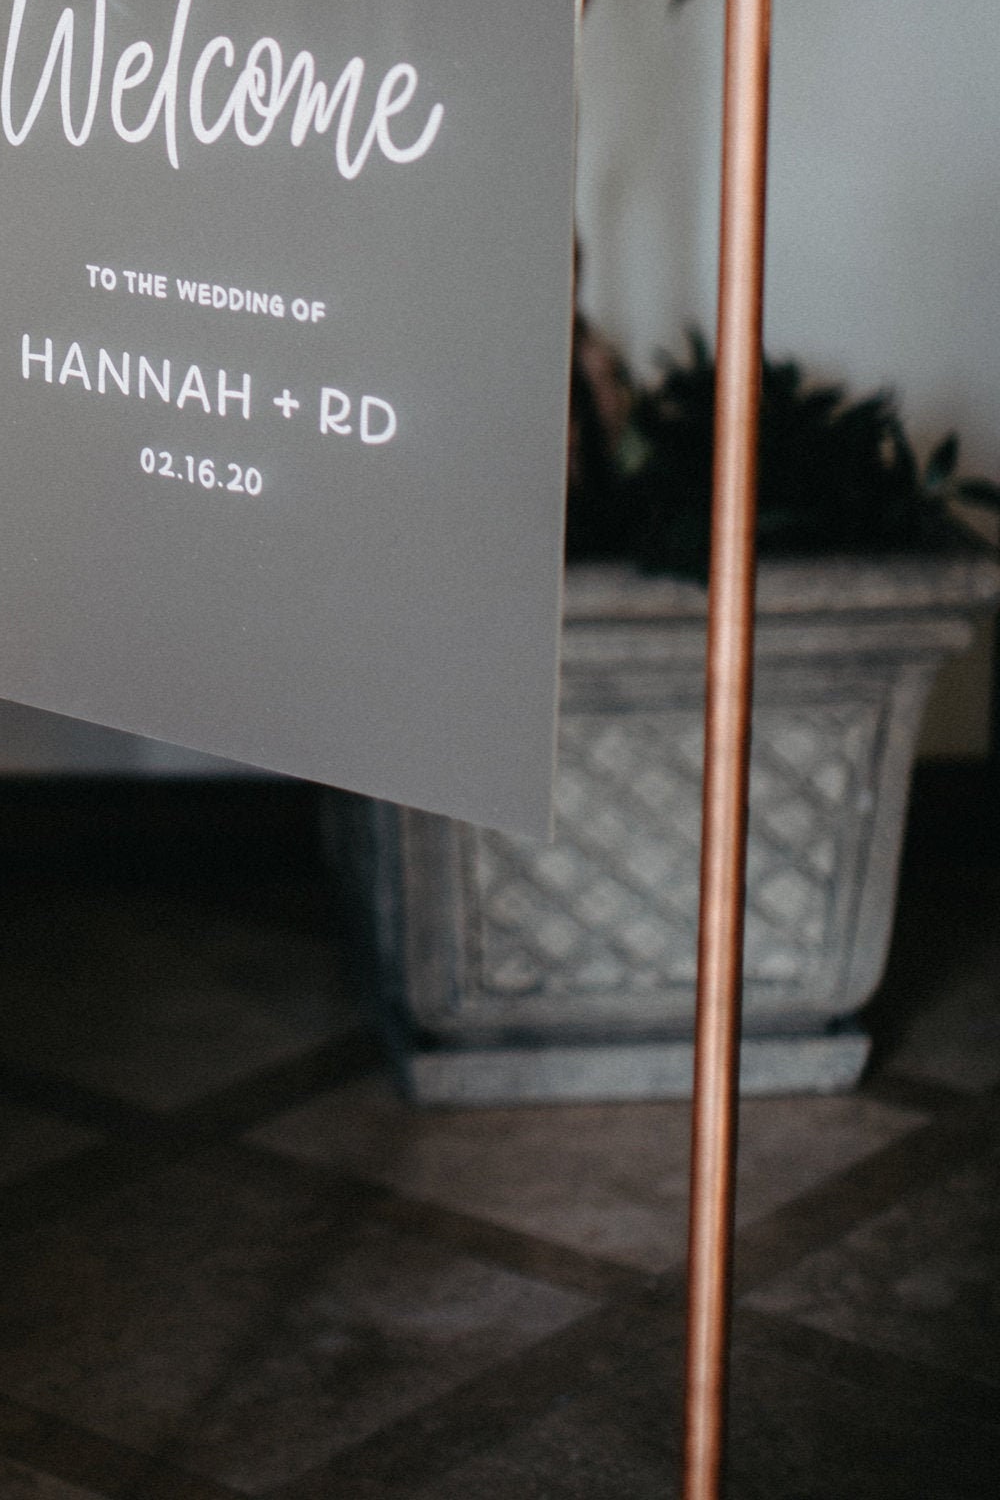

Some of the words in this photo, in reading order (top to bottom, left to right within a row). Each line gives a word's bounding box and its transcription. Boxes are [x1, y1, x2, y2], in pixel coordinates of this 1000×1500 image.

[85, 264, 117, 291] TO
[122, 270, 168, 299] THE
[175, 278, 286, 318] WEDDING
[290, 297, 326, 323] OF
[21, 333, 252, 420] HANNAH
[272, 388, 300, 419] +
[319, 386, 397, 445] RD
[140, 447, 263, 496] 02.16.20
